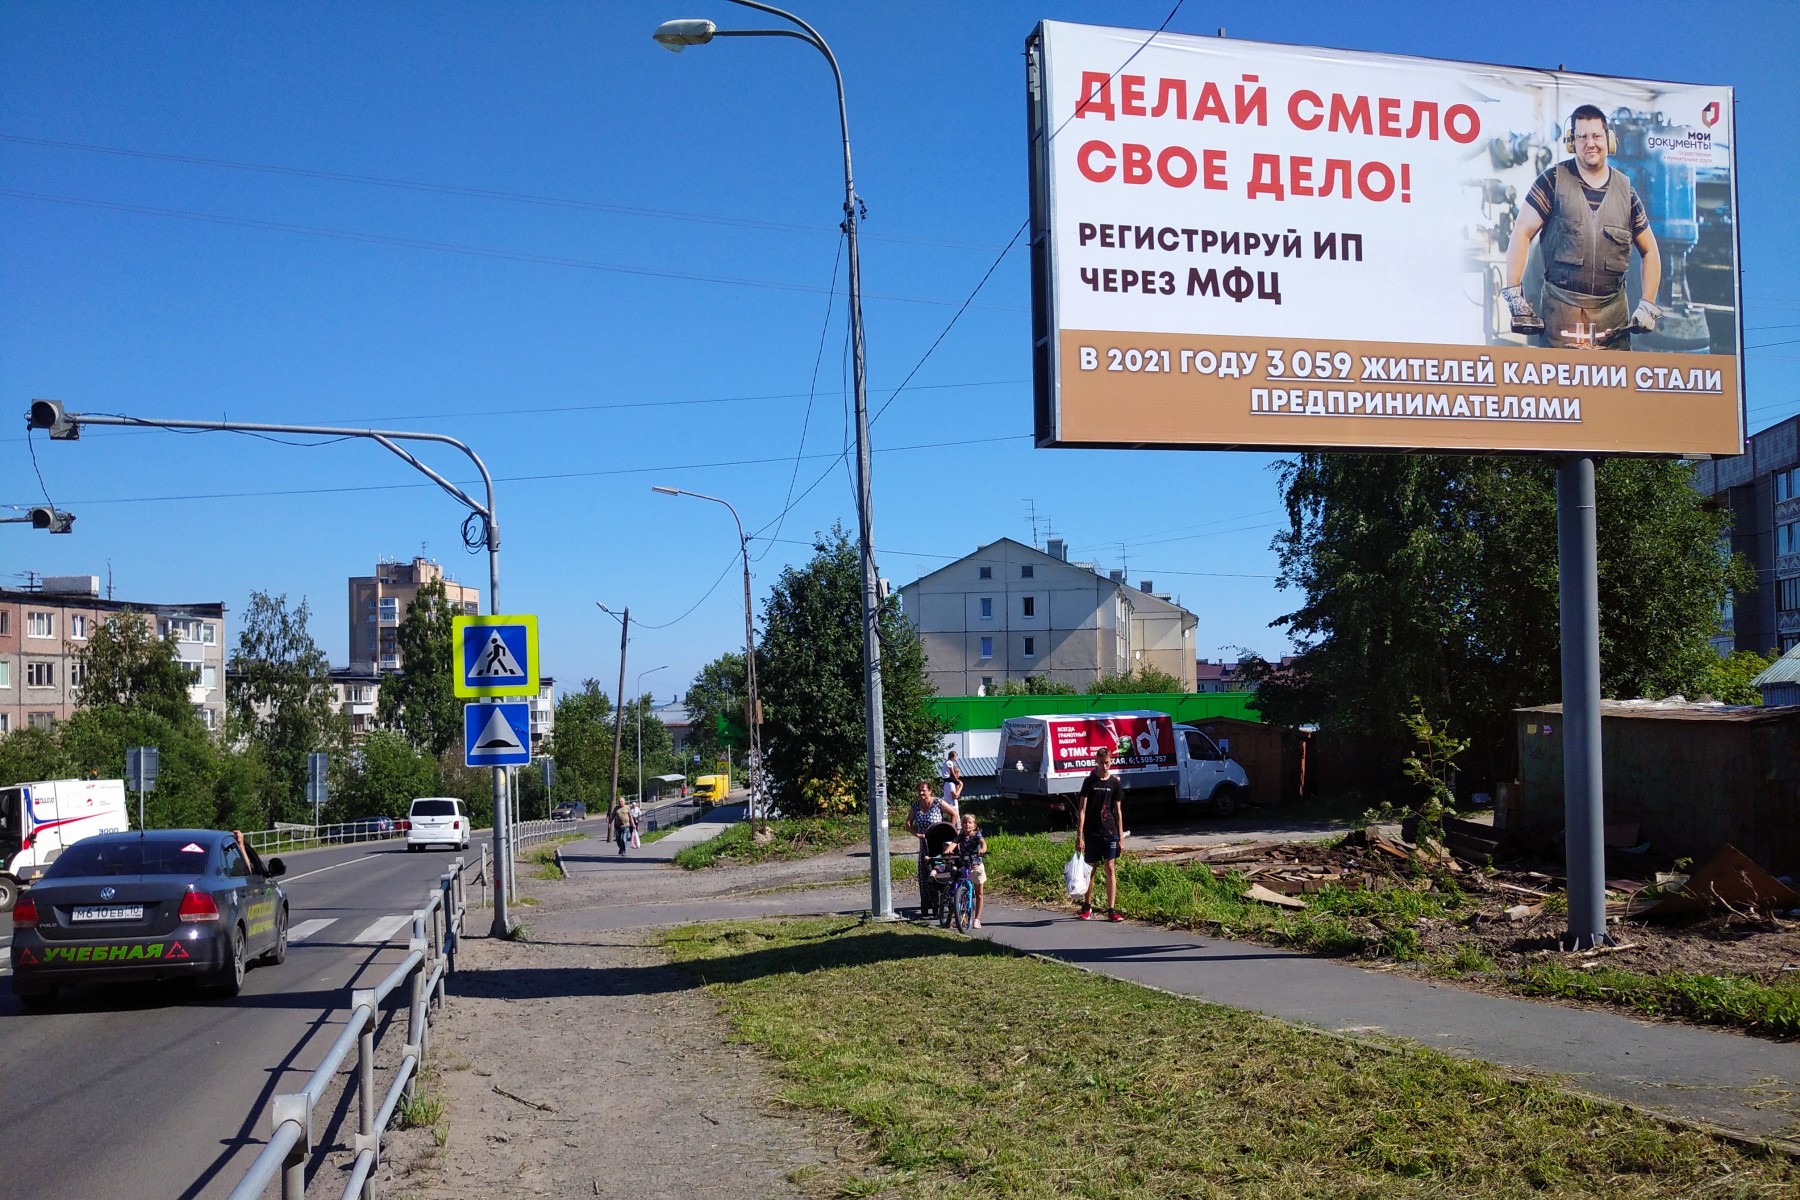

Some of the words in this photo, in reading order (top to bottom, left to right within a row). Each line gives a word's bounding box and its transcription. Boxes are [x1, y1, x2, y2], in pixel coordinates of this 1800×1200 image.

[1075, 71, 1267, 127] ДЕЛАЙ
[1287, 89, 1481, 144] СМЕЛО
[1648, 136, 1712, 150] документы
[1076, 140, 1228, 191] СВОЕ
[1246, 152, 1411, 204] ДЕЛО!
[1078, 222, 1302, 259] РЕГИСТРИРУЙ
[1313, 231, 1363, 262] ИП
[1080, 266, 1176, 296] ЧЕРЕЗ
[1186, 265, 1282, 306] МФЦ
[1079, 346, 1099, 371] В
[1107, 348, 1171, 373] 2021
[1180, 350, 1259, 379] ГОДУ
[1360, 354, 1496, 386] ЖИТЕЛЕЙ
[1502, 361, 1628, 389] КАРЕЛИИ
[1635, 366, 1723, 392] СТАЛИ
[1250, 388, 1581, 421] ПРЕДПРИНИМАТЕЛЯМИ
[1067, 747, 1089, 757] ТМК
[43, 943, 165, 963] УЧЕБНАЯ
